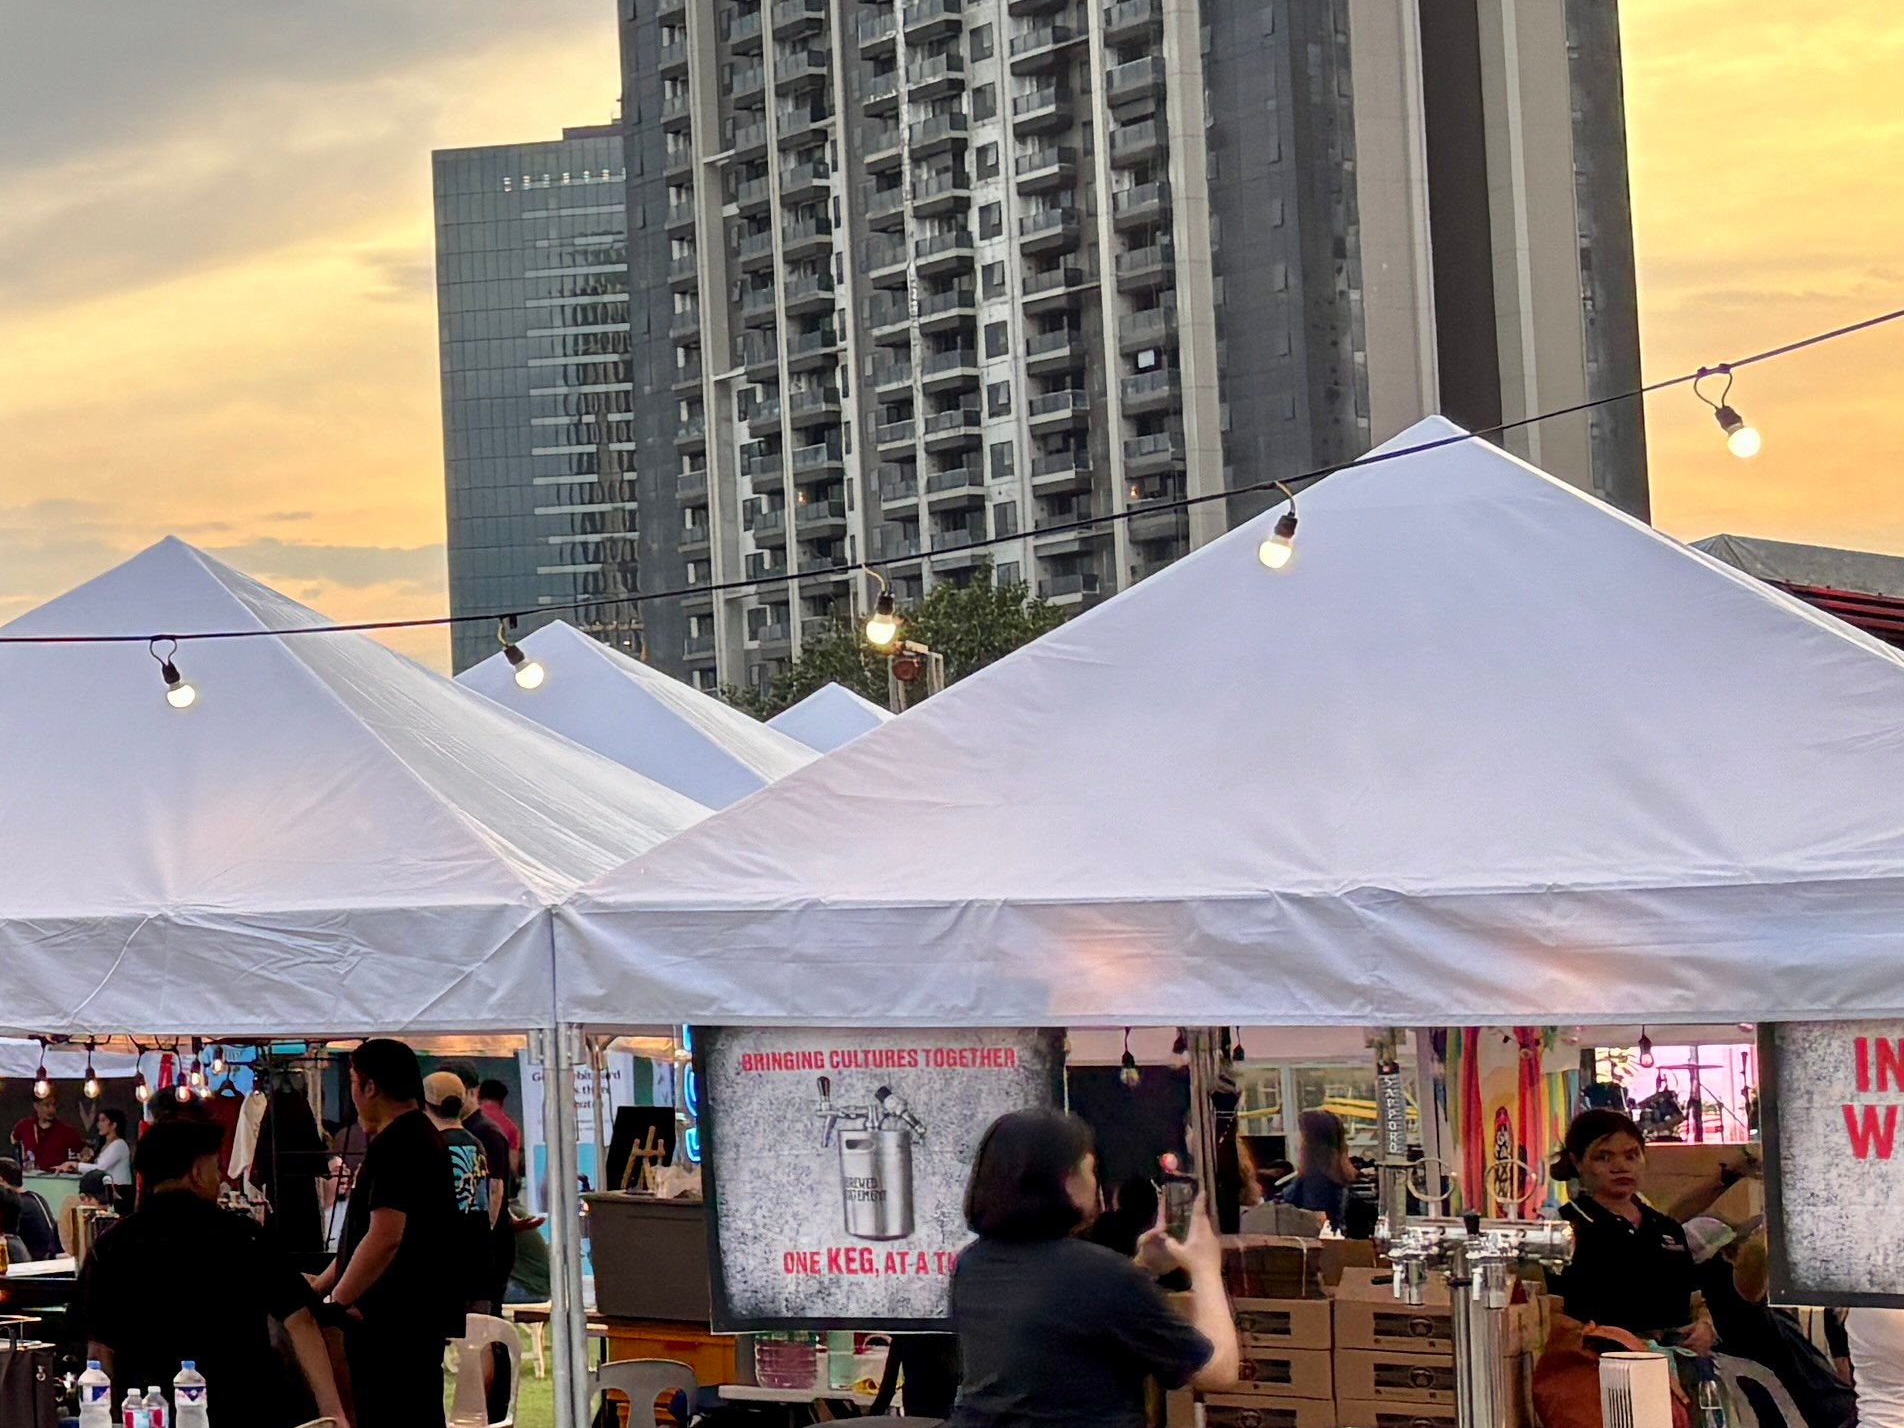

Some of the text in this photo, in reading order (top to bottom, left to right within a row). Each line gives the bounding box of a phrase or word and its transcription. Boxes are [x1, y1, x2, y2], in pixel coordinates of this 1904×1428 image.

[742, 1047, 1017, 1071] BRINGING CULTURES TOGETHER
[783, 1251, 821, 1274] ONE
[827, 1247, 879, 1277] KEG,
[884, 1251, 909, 1274] AT
[916, 1251, 929, 1275] A
